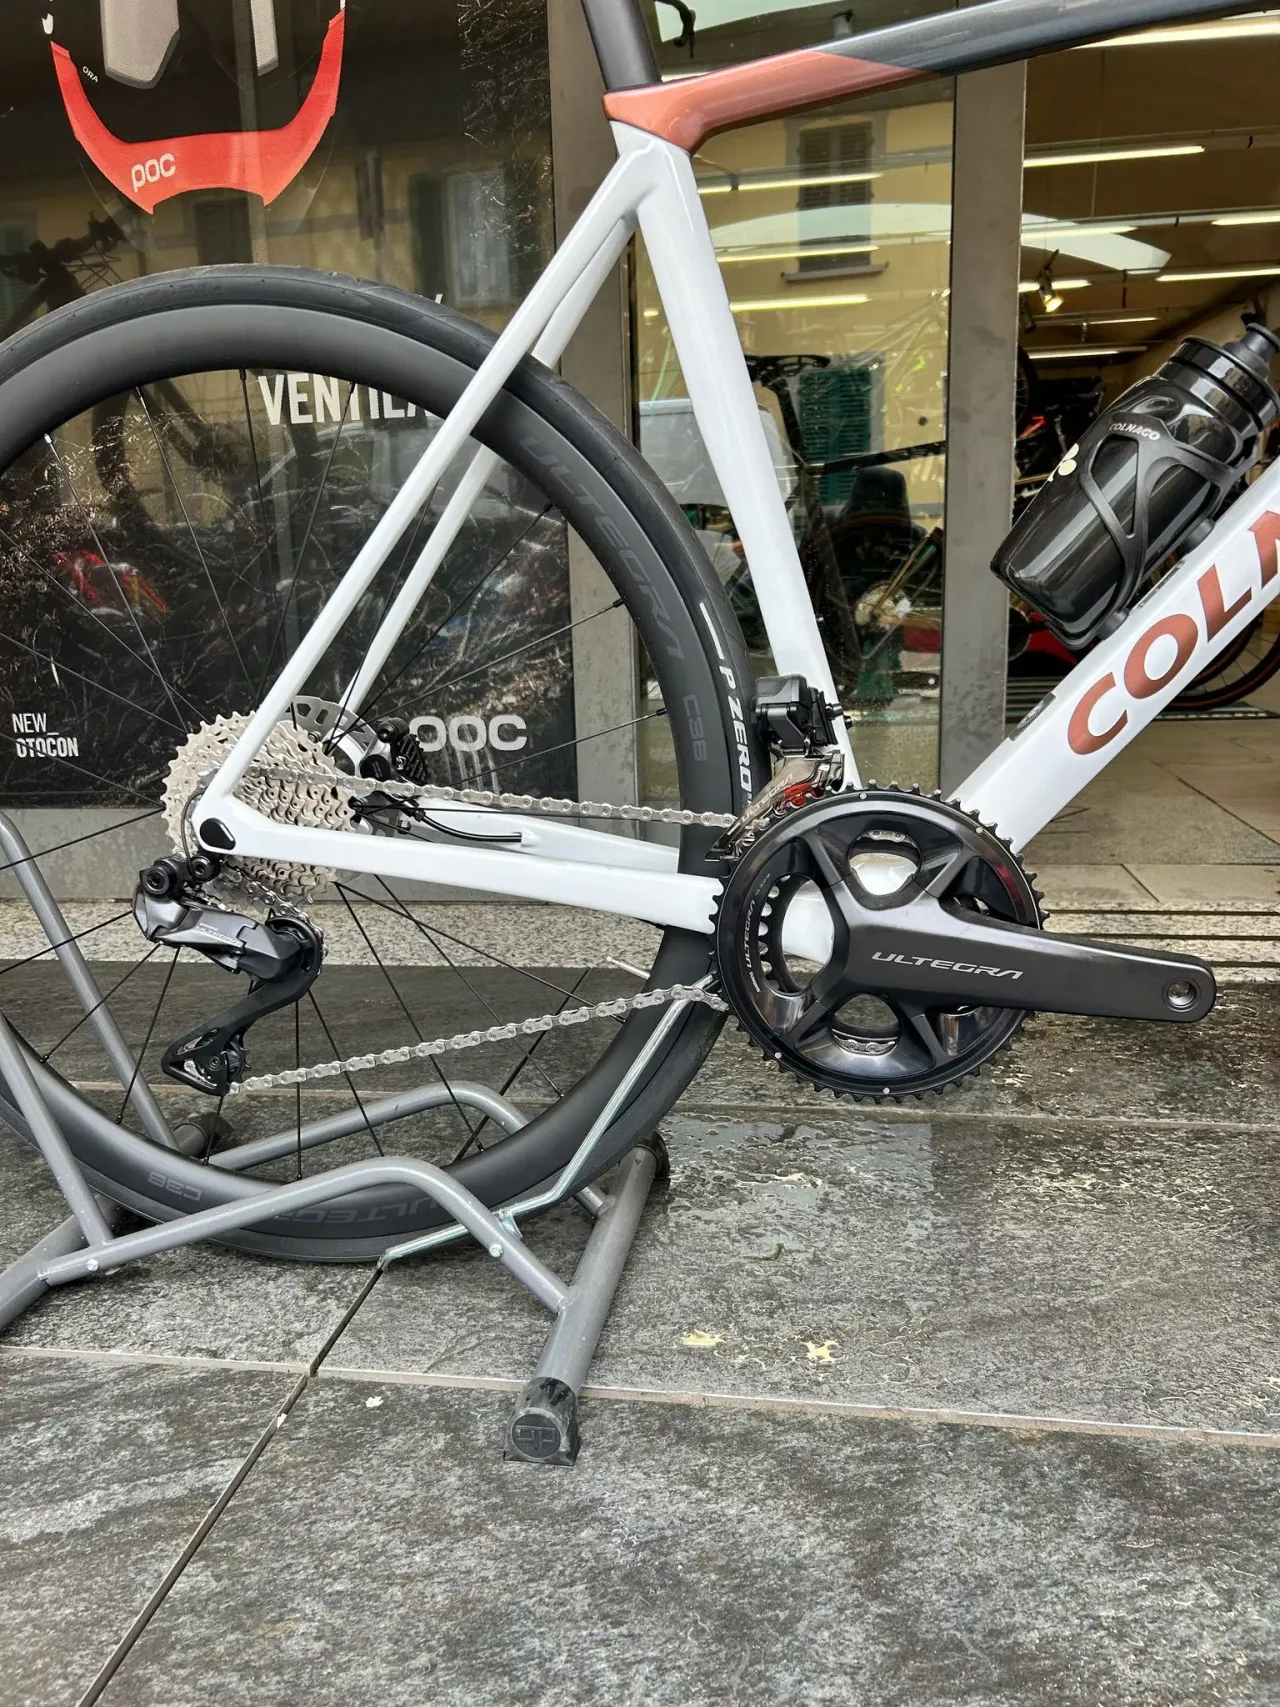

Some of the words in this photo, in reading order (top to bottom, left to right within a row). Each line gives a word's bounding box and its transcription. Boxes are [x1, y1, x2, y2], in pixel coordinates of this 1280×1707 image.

[82, 65, 99, 82] ORA
[257, 373, 434, 426] VENTIL
[1108, 422, 1161, 440] COLNAGO
[519, 436, 686, 660] ULTEGRA
[16, 737, 79, 757] OTOCON
[684, 694, 708, 762] C36
[719, 665, 736, 690] P
[728, 695, 752, 793] ZERO
[741, 773, 794, 823] ULTEGRA
[744, 899, 756, 969] ULTEGRA
[872, 951, 1024, 980] ULTEGRA
